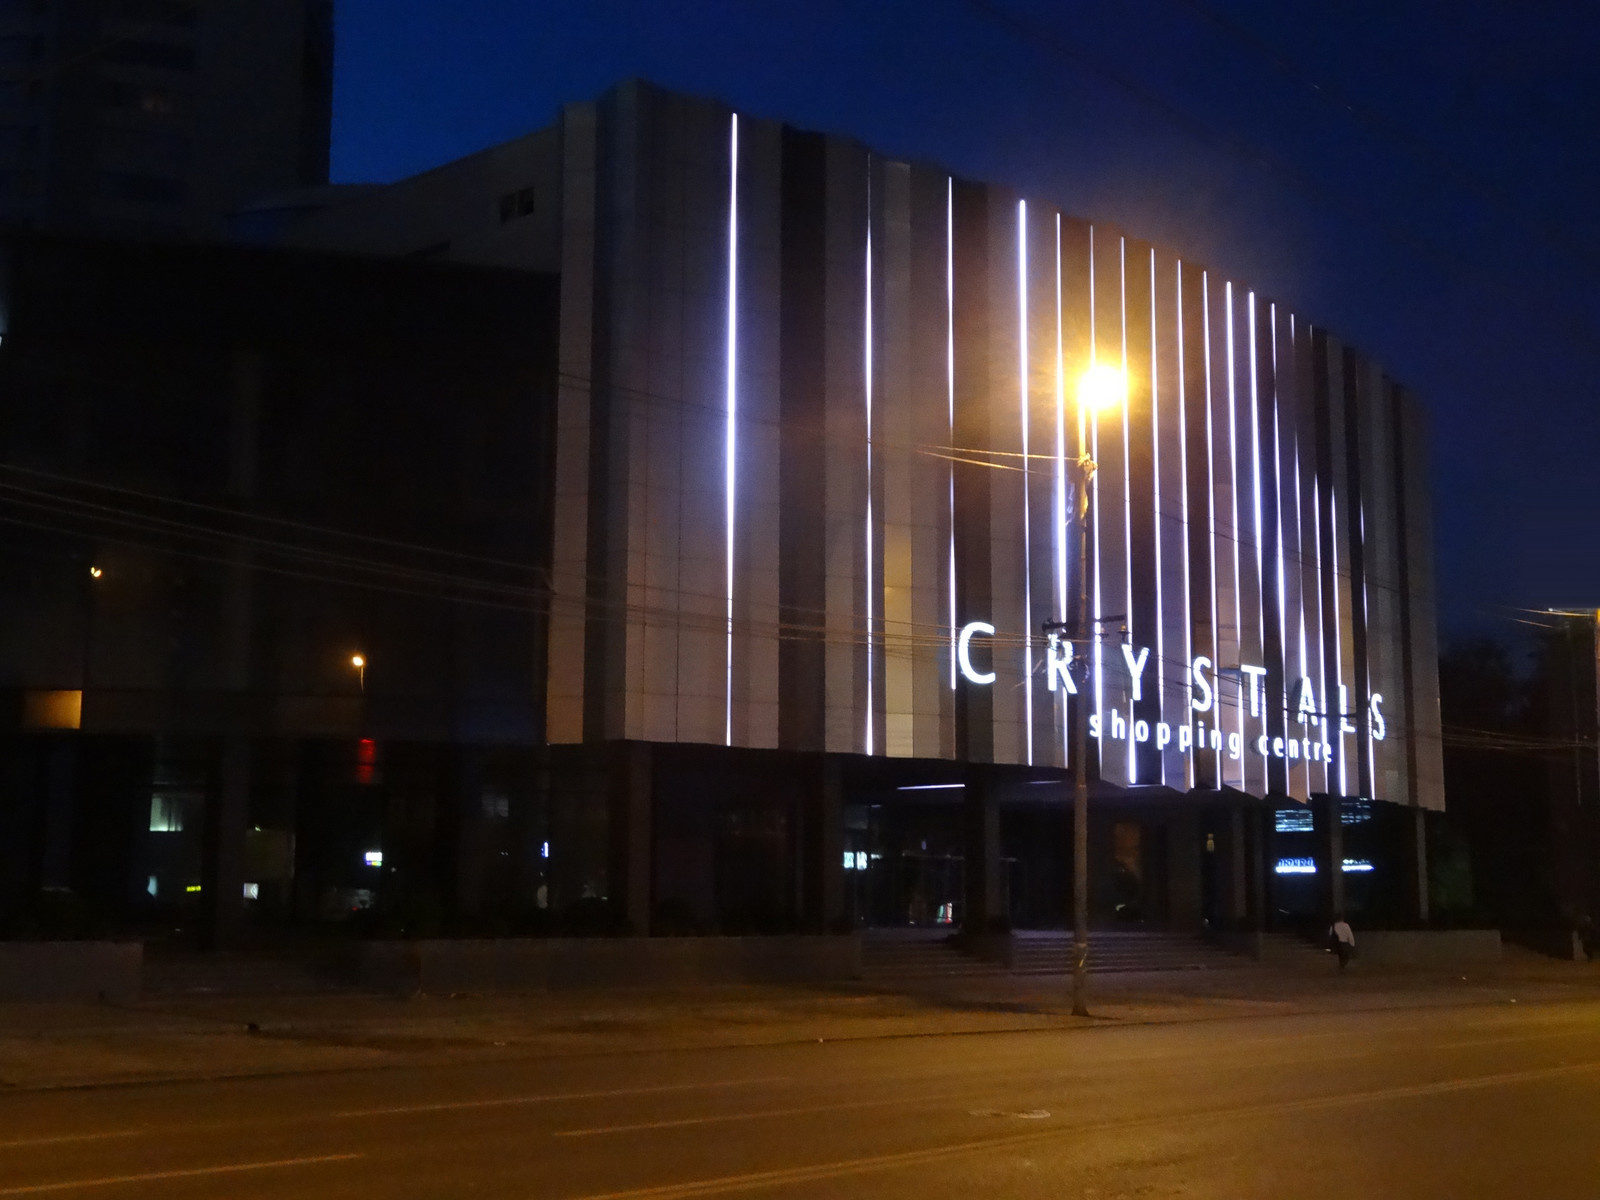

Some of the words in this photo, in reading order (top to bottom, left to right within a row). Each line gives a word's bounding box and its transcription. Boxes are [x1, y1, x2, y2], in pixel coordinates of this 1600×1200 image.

[958, 622, 1386, 741] CRYSTALS
[1089, 709, 1242, 760] shopping
[1258, 735, 1333, 763] centre
